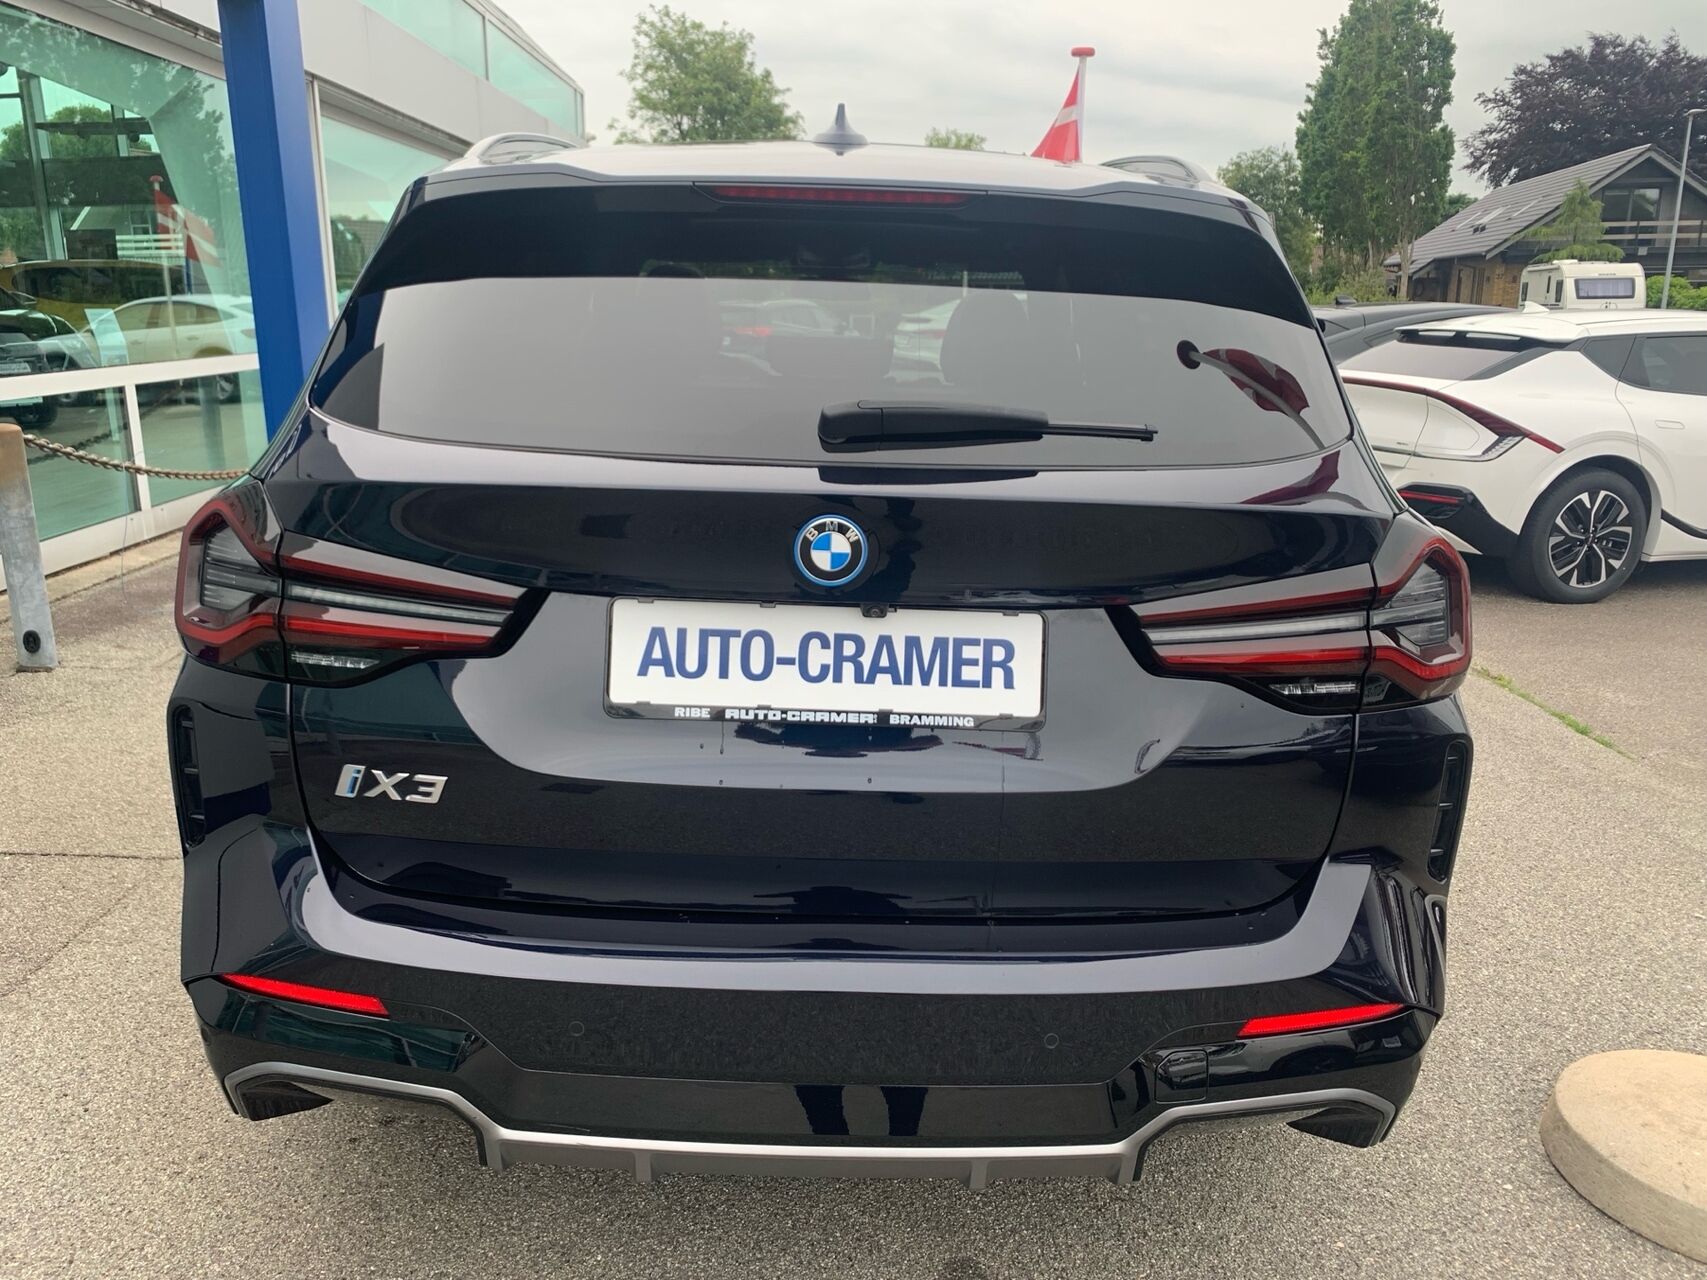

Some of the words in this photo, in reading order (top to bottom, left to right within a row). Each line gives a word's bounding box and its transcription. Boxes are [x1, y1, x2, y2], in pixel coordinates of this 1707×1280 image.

[805, 520, 859, 543] BMW
[637, 626, 1015, 690] AUTO-CRAMER
[674, 706, 711, 718] RIBE
[725, 708, 874, 723] AUTO-CRAMER
[889, 714, 975, 727] BRAMMING
[334, 763, 449, 805] iX3
